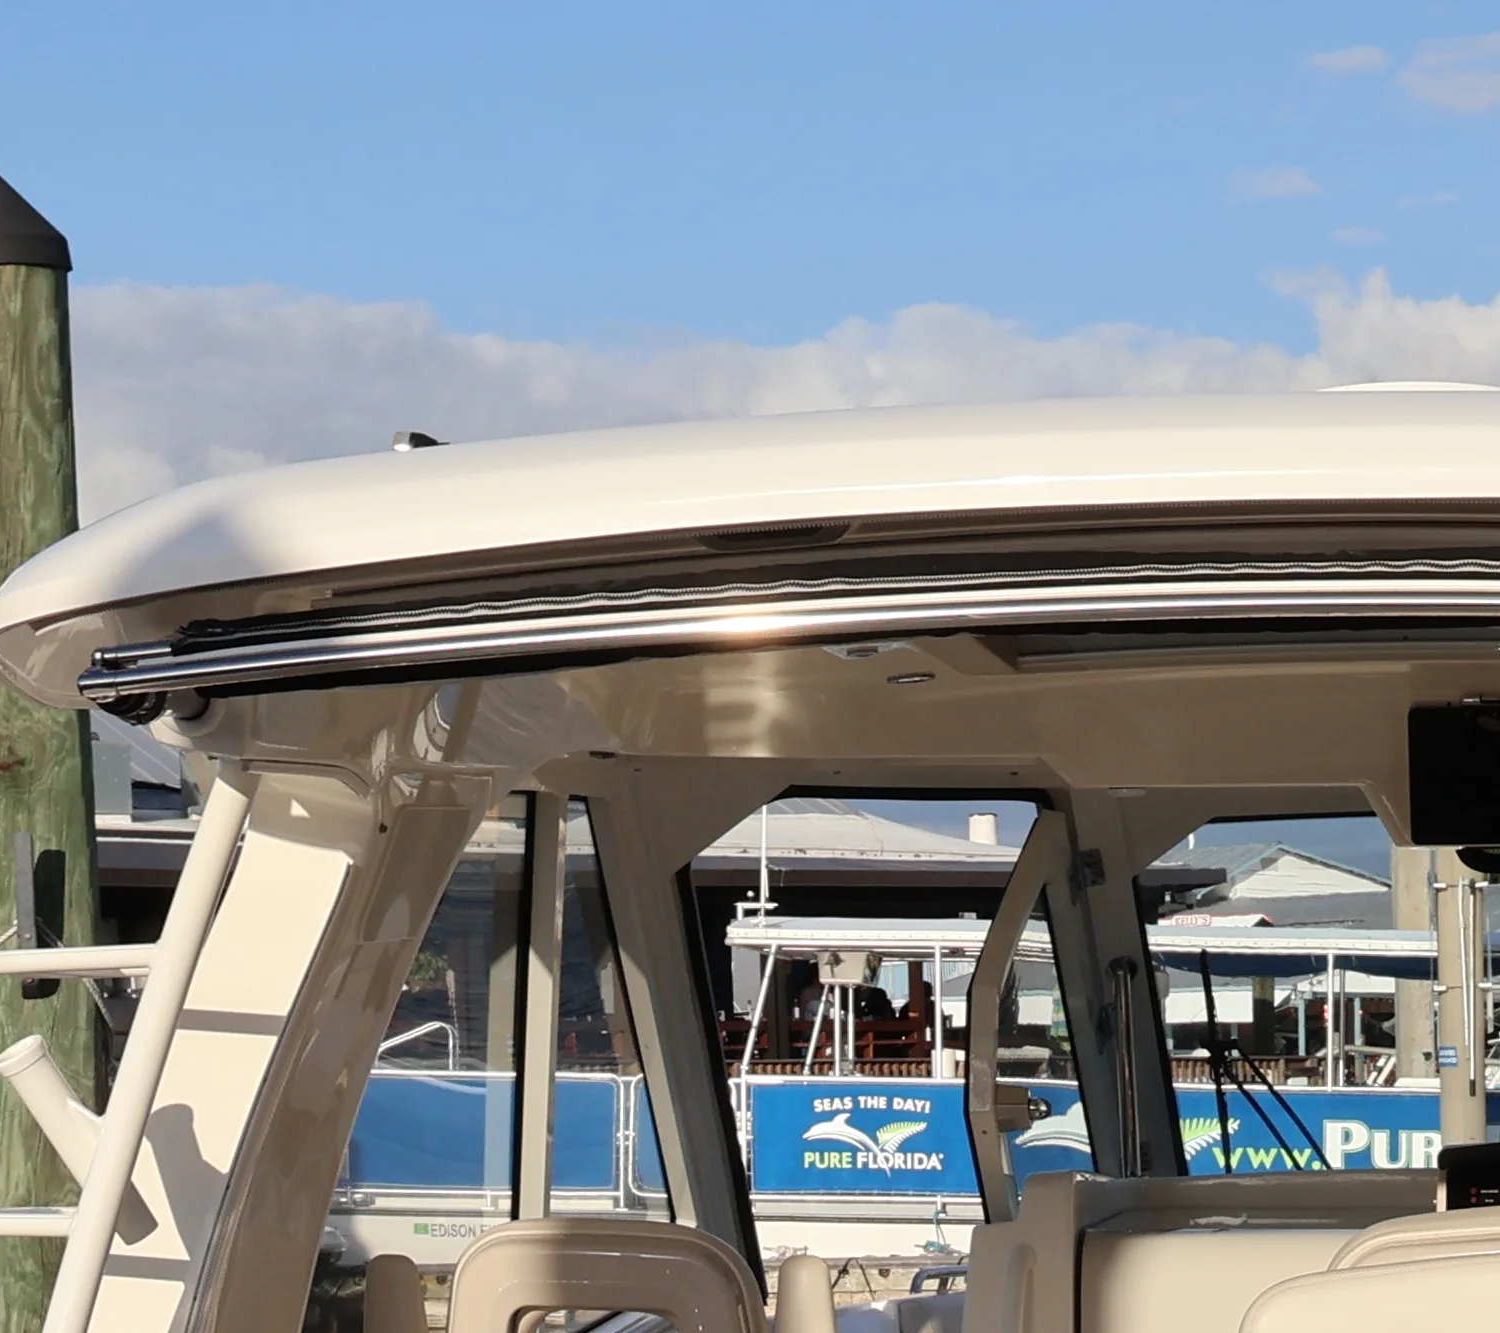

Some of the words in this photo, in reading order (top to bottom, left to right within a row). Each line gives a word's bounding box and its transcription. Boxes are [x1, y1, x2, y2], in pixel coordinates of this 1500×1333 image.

[813, 1096, 853, 1113] SEAS
[857, 1095, 887, 1109] THE
[892, 1097, 931, 1114] DAY!
[803, 1151, 853, 1169] PURE
[430, 1223, 477, 1238] EDISON
